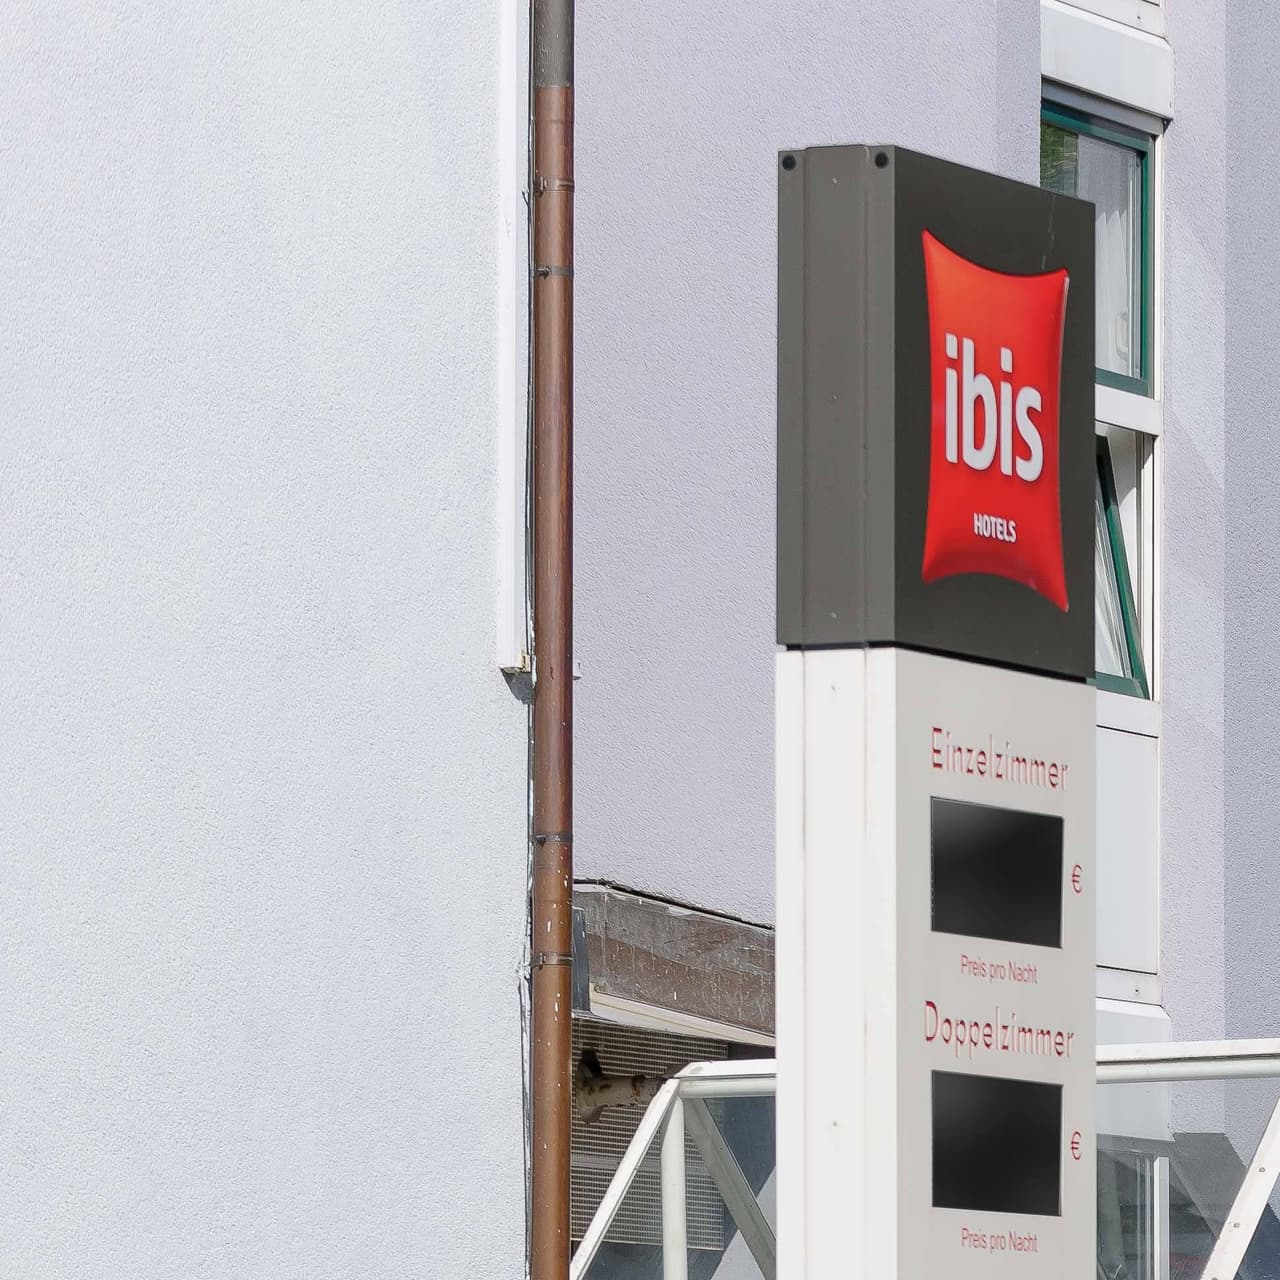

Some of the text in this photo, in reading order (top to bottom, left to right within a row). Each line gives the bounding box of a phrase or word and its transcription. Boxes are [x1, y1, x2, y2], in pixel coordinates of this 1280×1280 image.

[946, 333, 1043, 482] ibis
[974, 513, 1017, 543] HOTELS
[931, 726, 1068, 790] Einzelzimmer
[1071, 864, 1083, 894] €
[960, 954, 1038, 984] Preis pro Nacht
[924, 1001, 1074, 1059] Doppelzimmer
[1070, 1131, 1082, 1160] €
[961, 1227, 1038, 1254] Preis pro Nacht
